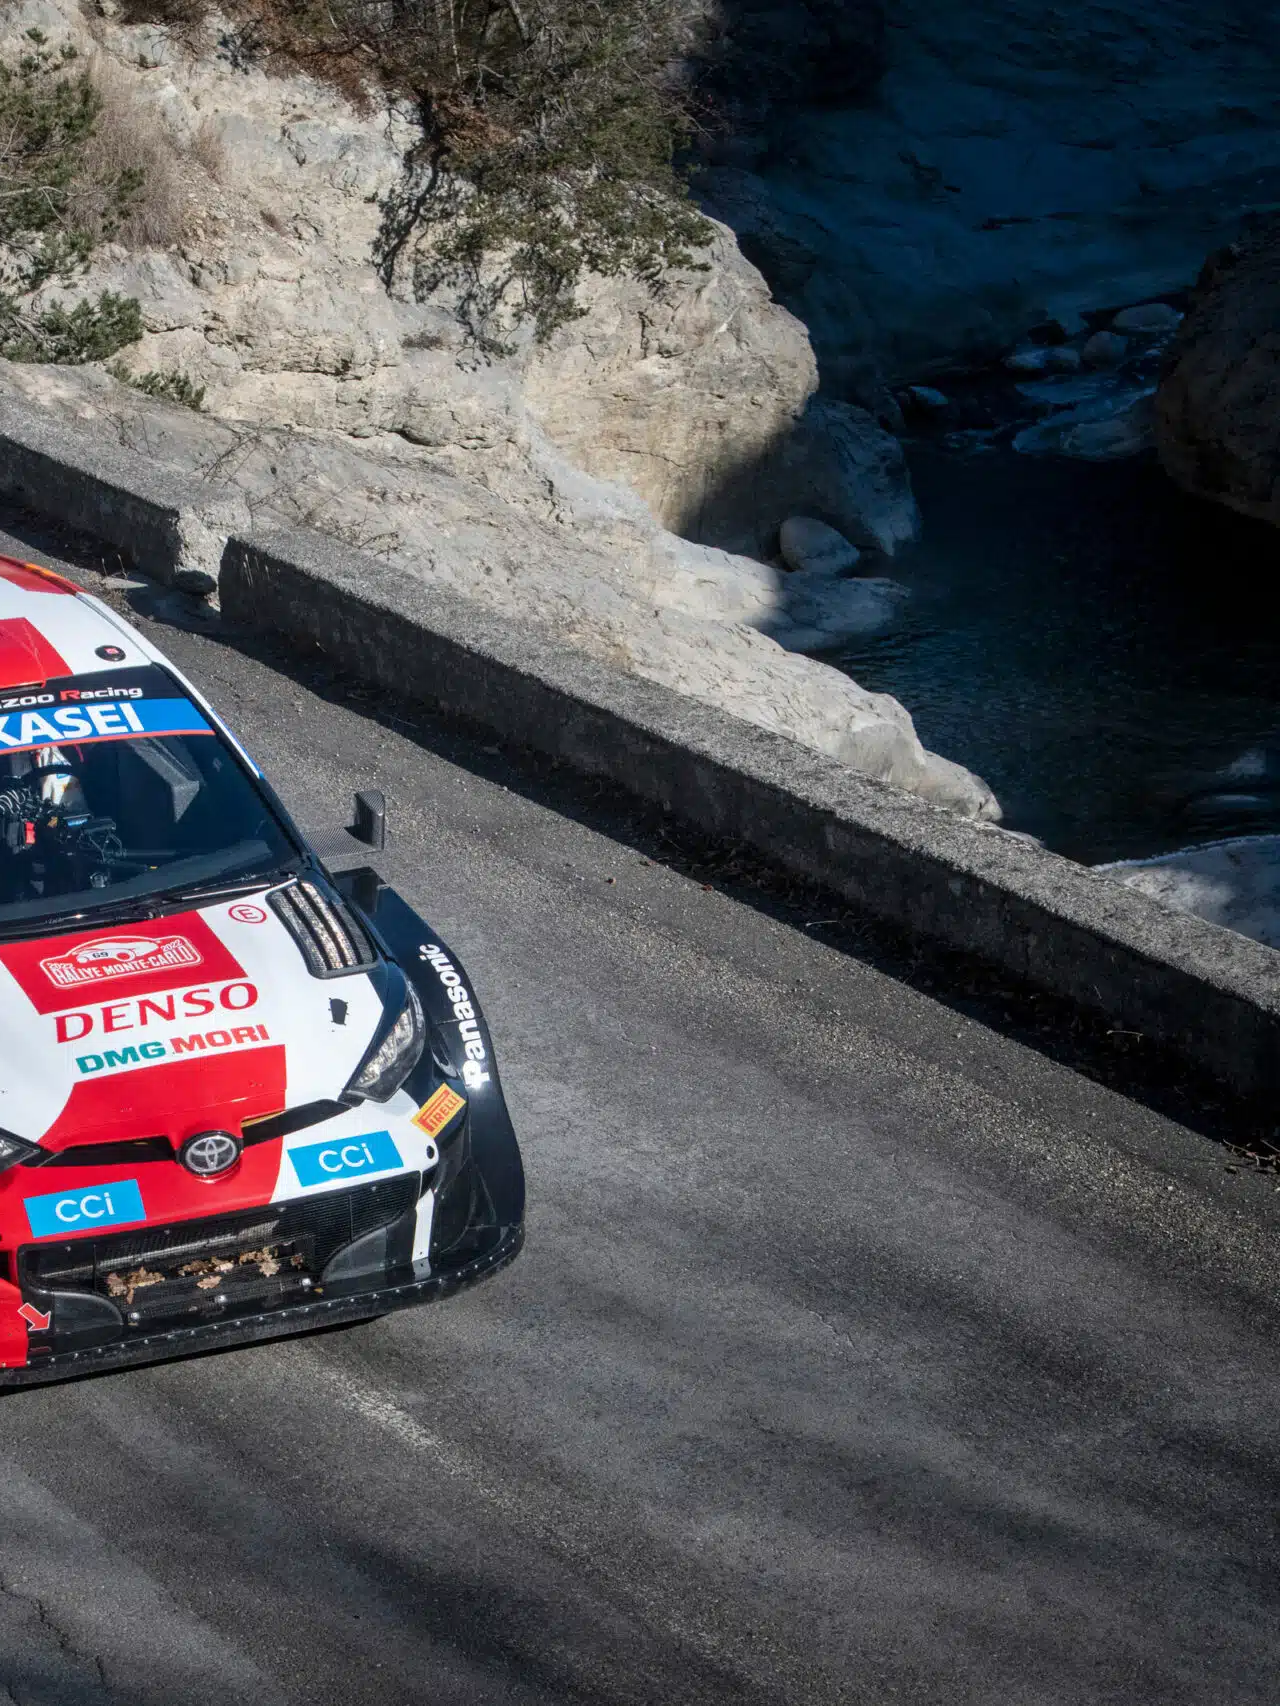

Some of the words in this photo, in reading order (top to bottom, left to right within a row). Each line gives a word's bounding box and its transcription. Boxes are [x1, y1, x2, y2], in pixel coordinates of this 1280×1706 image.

[59, 687, 144, 702] Racing
[52, 964, 103, 985] RALLYE
[104, 946, 195, 976] MONTE-CARLO
[91, 951, 109, 959] 69
[160, 938, 183, 953] 2022
[54, 982, 259, 1044] DENSO
[418, 943, 491, 1089] Panasonic
[75, 1040, 166, 1074] DMG
[170, 1023, 270, 1054] MORI
[417, 1088, 460, 1133] PIRELLI
